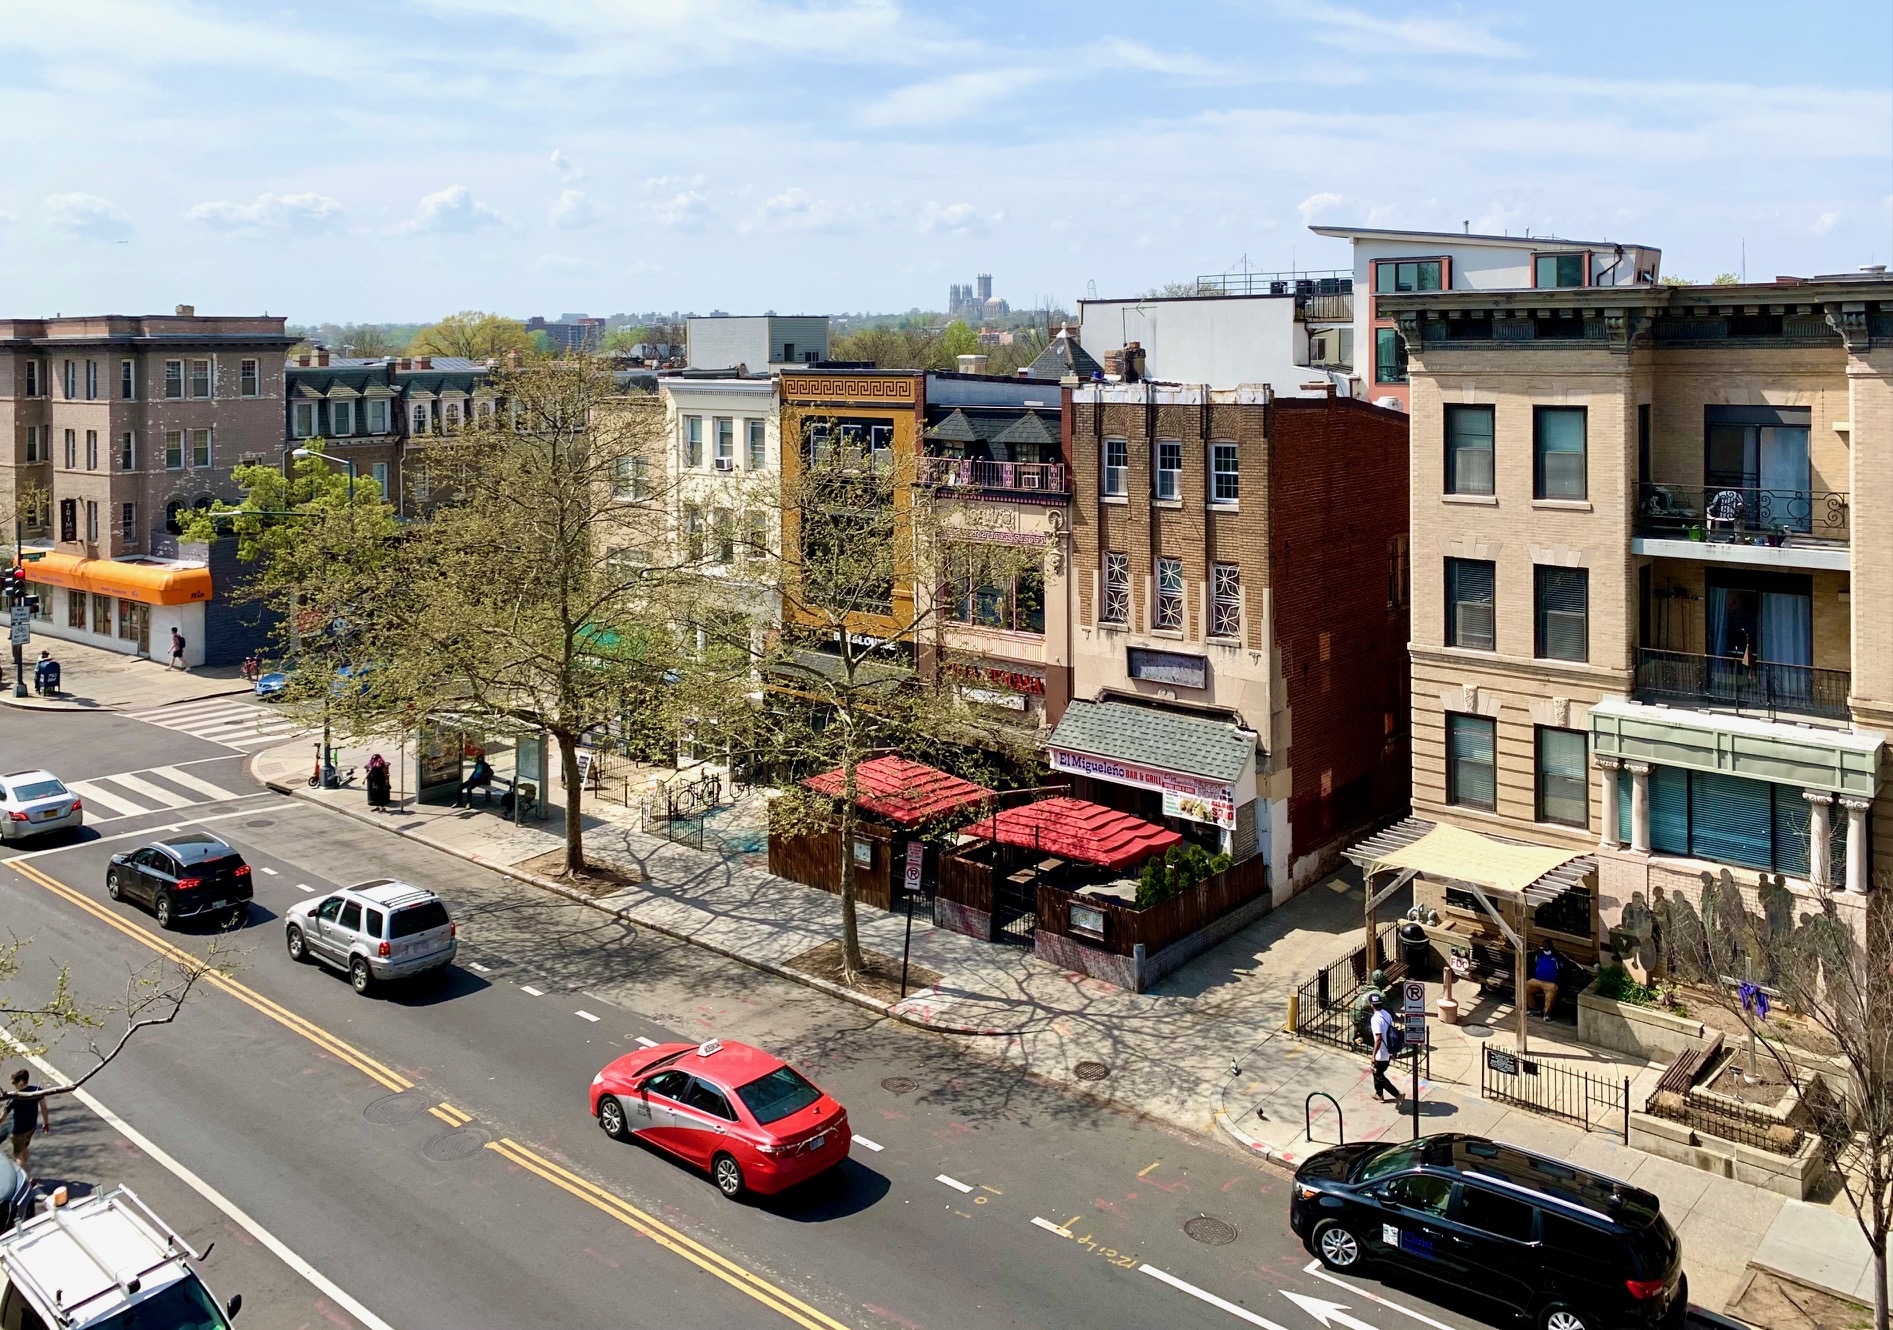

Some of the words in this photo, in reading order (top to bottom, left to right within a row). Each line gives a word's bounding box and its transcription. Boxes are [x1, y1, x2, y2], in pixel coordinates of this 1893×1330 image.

[65, 502, 73, 528] TRIM
[190, 590, 205, 599] Ria
[833, 631, 851, 643] BR
[1059, 752, 1070, 766] El
[1072, 755, 1125, 778] Migueleño
[1125, 769, 1138, 780] BAR
[1139, 772, 1144, 781] &
[1145, 773, 1162, 786] GRILL
